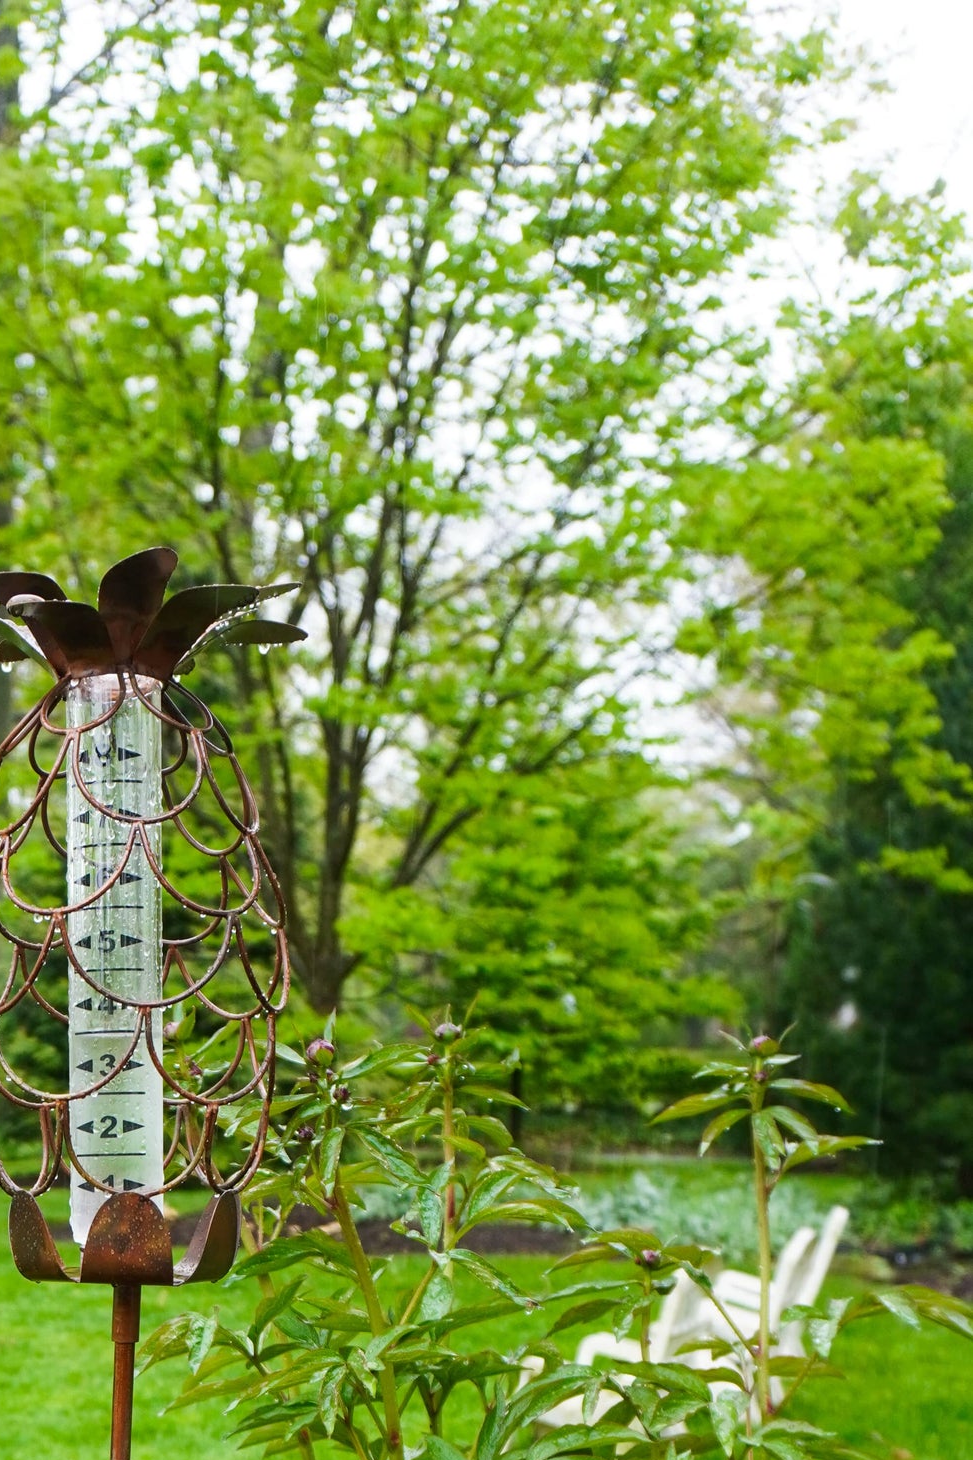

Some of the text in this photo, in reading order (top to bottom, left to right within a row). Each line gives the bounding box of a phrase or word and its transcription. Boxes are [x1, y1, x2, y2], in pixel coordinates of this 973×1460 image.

[98, 930, 116, 953] 5
[98, 994, 117, 1015] 4
[99, 1054, 117, 1077] 3
[99, 1115, 118, 1139] 2
